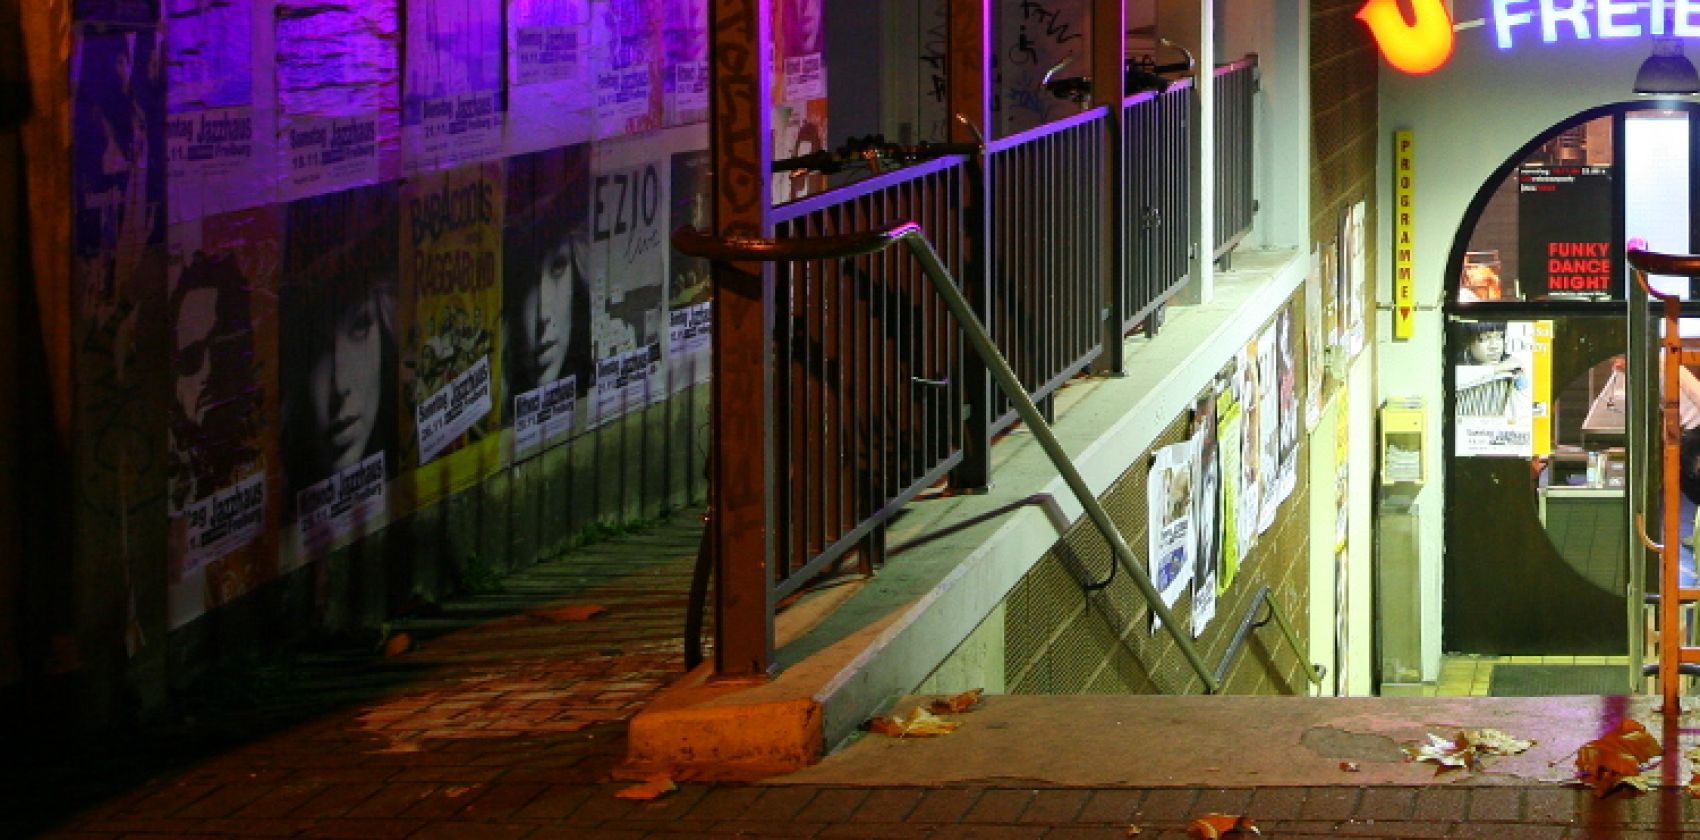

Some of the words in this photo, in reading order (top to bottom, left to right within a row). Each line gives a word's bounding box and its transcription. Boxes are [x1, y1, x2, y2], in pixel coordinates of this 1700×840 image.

[197, 112, 252, 144] Jazzhaus
[594, 164, 658, 241] EZIO
[1400, 139, 1411, 298] PROGRAMME
[1548, 242, 1610, 257] FUNKY
[1548, 258, 1611, 273] DANCE
[1548, 276, 1611, 290] NIGHT
